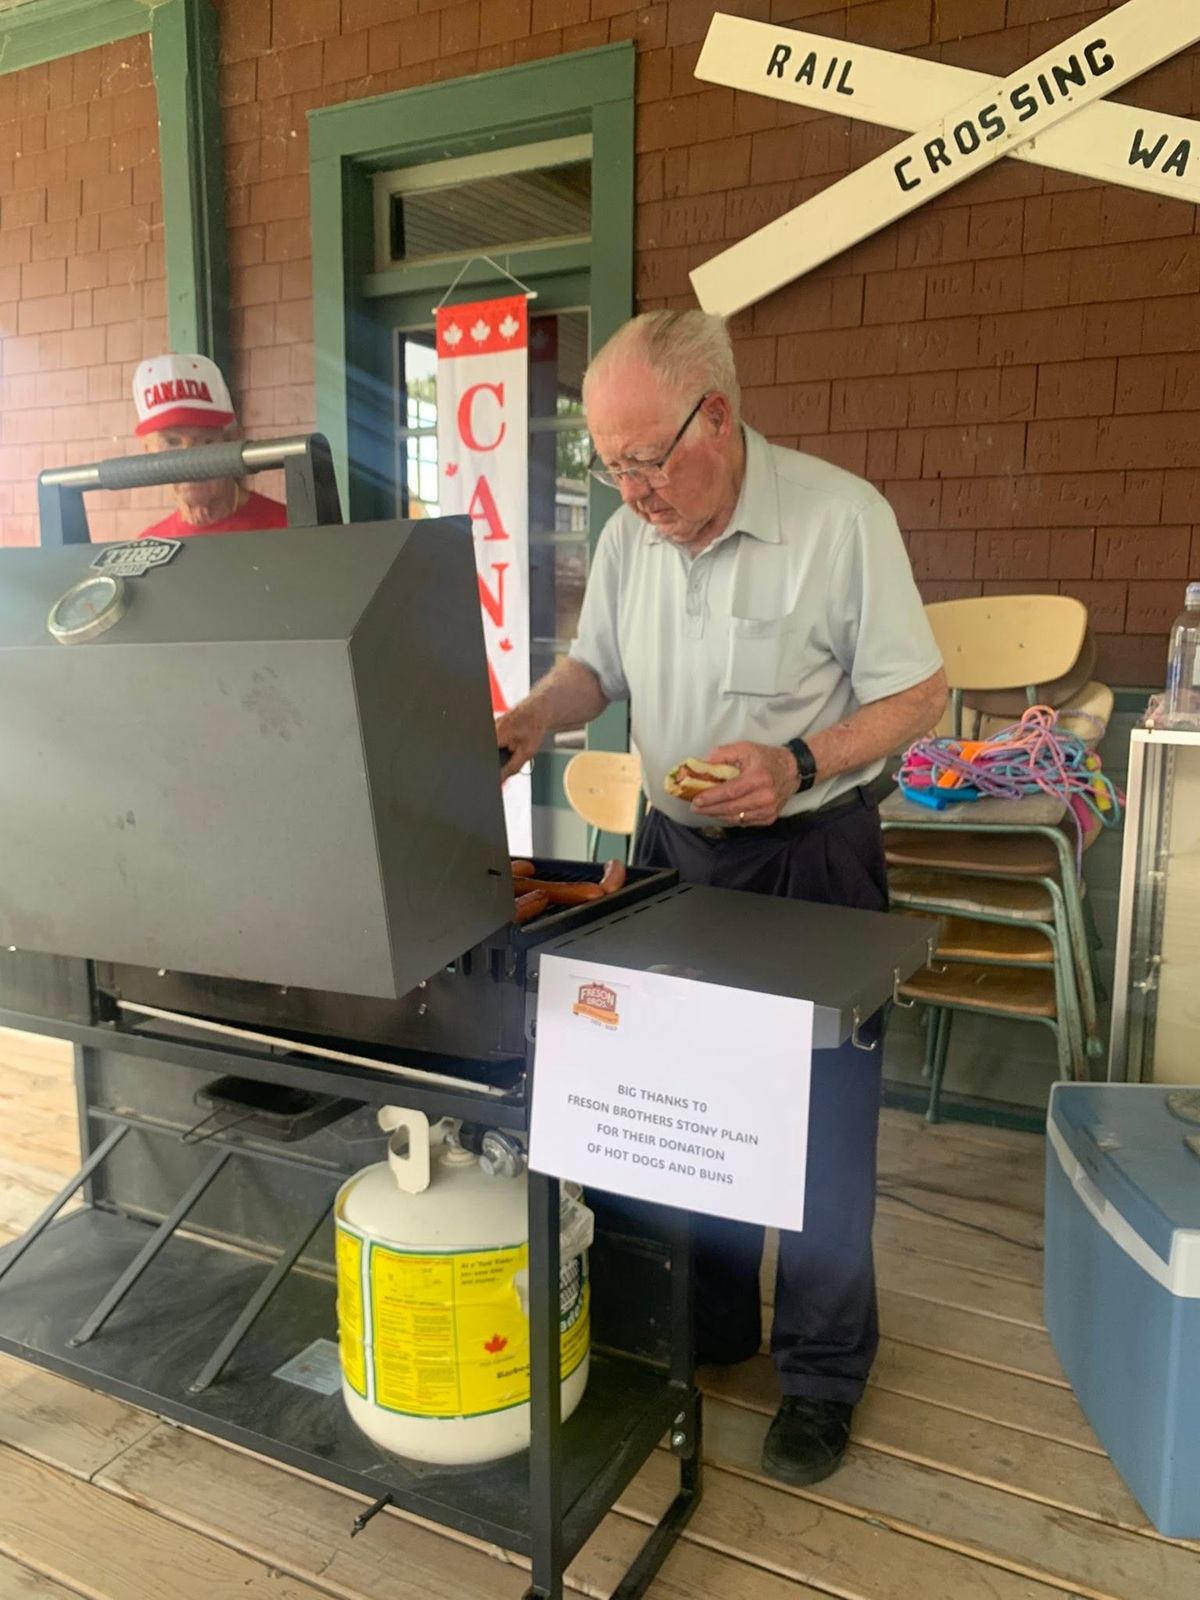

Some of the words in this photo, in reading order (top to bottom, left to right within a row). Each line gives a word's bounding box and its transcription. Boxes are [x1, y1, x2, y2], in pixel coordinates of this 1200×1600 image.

[766, 44, 855, 96] RAIL
[893, 38, 1115, 192] CROSSING
[1128, 128, 1191, 177] WA
[144, 379, 214, 410] CANADA
[617, 1084, 638, 1098] BIG
[640, 1089, 689, 1109] THANKS
[567, 1094, 610, 1114] FRESON
[612, 1105, 674, 1128] BROTHERS
[676, 1119, 718, 1138] STONY
[720, 1129, 759, 1146] PLAIN
[596, 1123, 620, 1138] FOR
[622, 1129, 657, 1146] THEIR
[658, 1138, 726, 1161] DONATION
[586, 1142, 602, 1154] OF
[604, 1147, 629, 1162] HOT
[632, 1154, 666, 1170] DOGS
[667, 1162, 697, 1177] AND
[699, 1168, 734, 1185] BUNS
